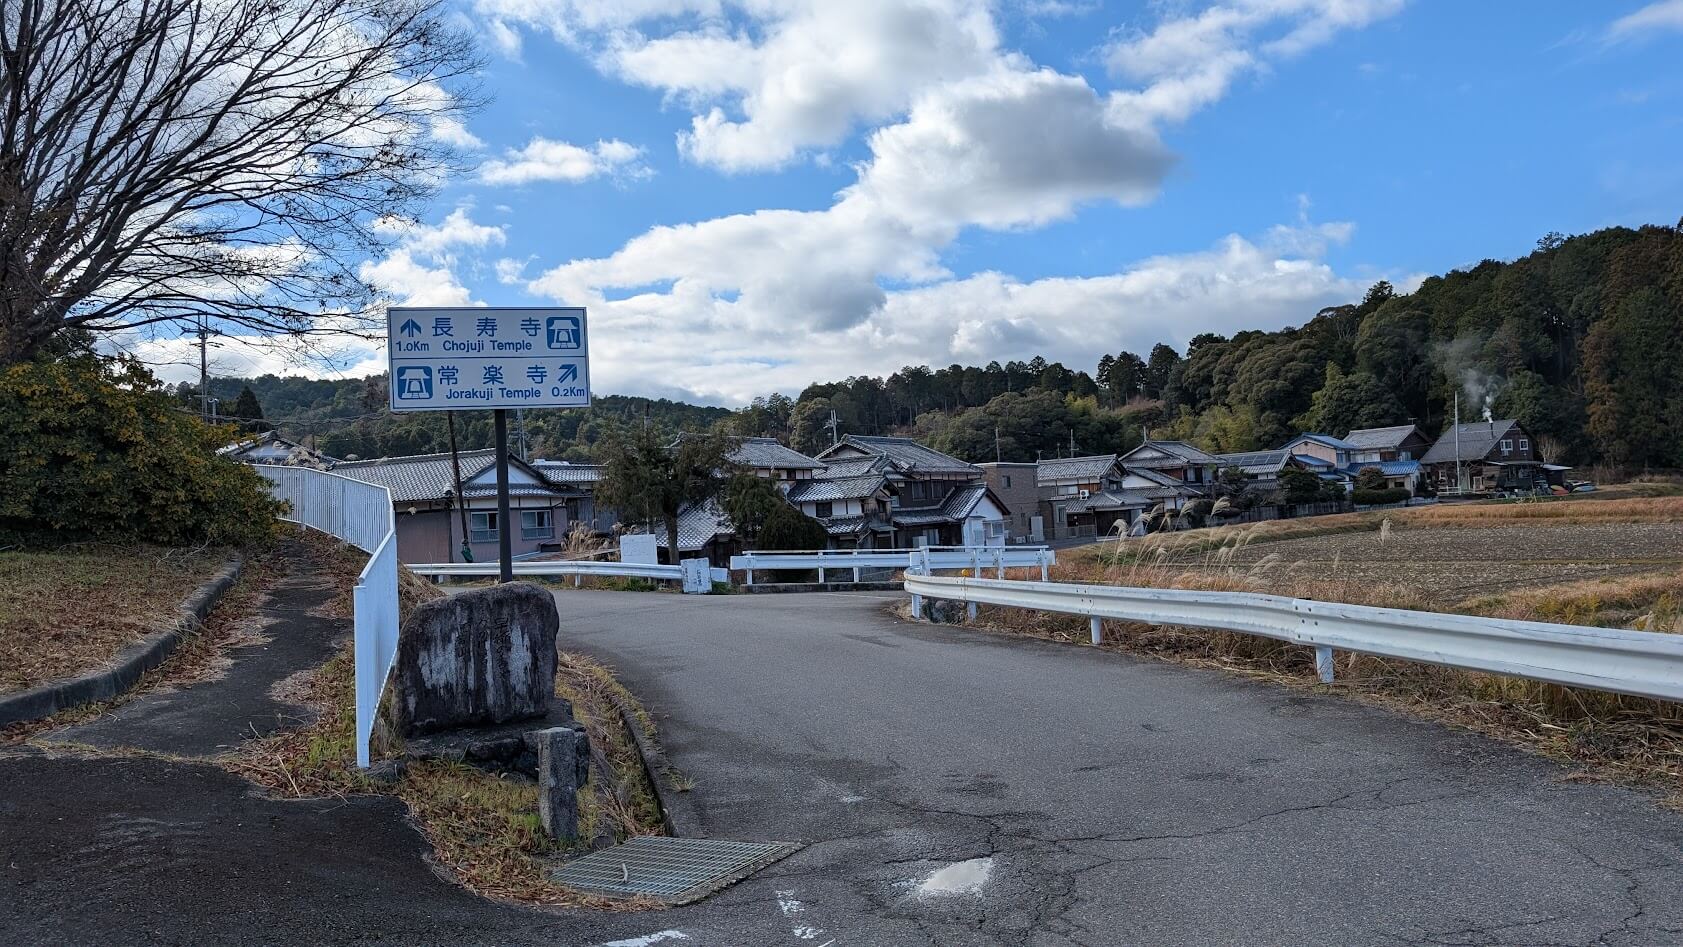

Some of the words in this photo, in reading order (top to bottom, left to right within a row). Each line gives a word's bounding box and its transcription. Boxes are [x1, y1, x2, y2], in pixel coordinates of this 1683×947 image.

[432, 316, 541, 337] 長寿寺
[396, 340, 429, 352] 1.0Km
[442, 340, 484, 353] Chojuji
[490, 340, 532, 352] Temple
[438, 364, 547, 385] 常楽寺
[446, 387, 493, 400] Jorakuji
[499, 387, 541, 400] Temple
[551, 386, 585, 397] 0.2Km
